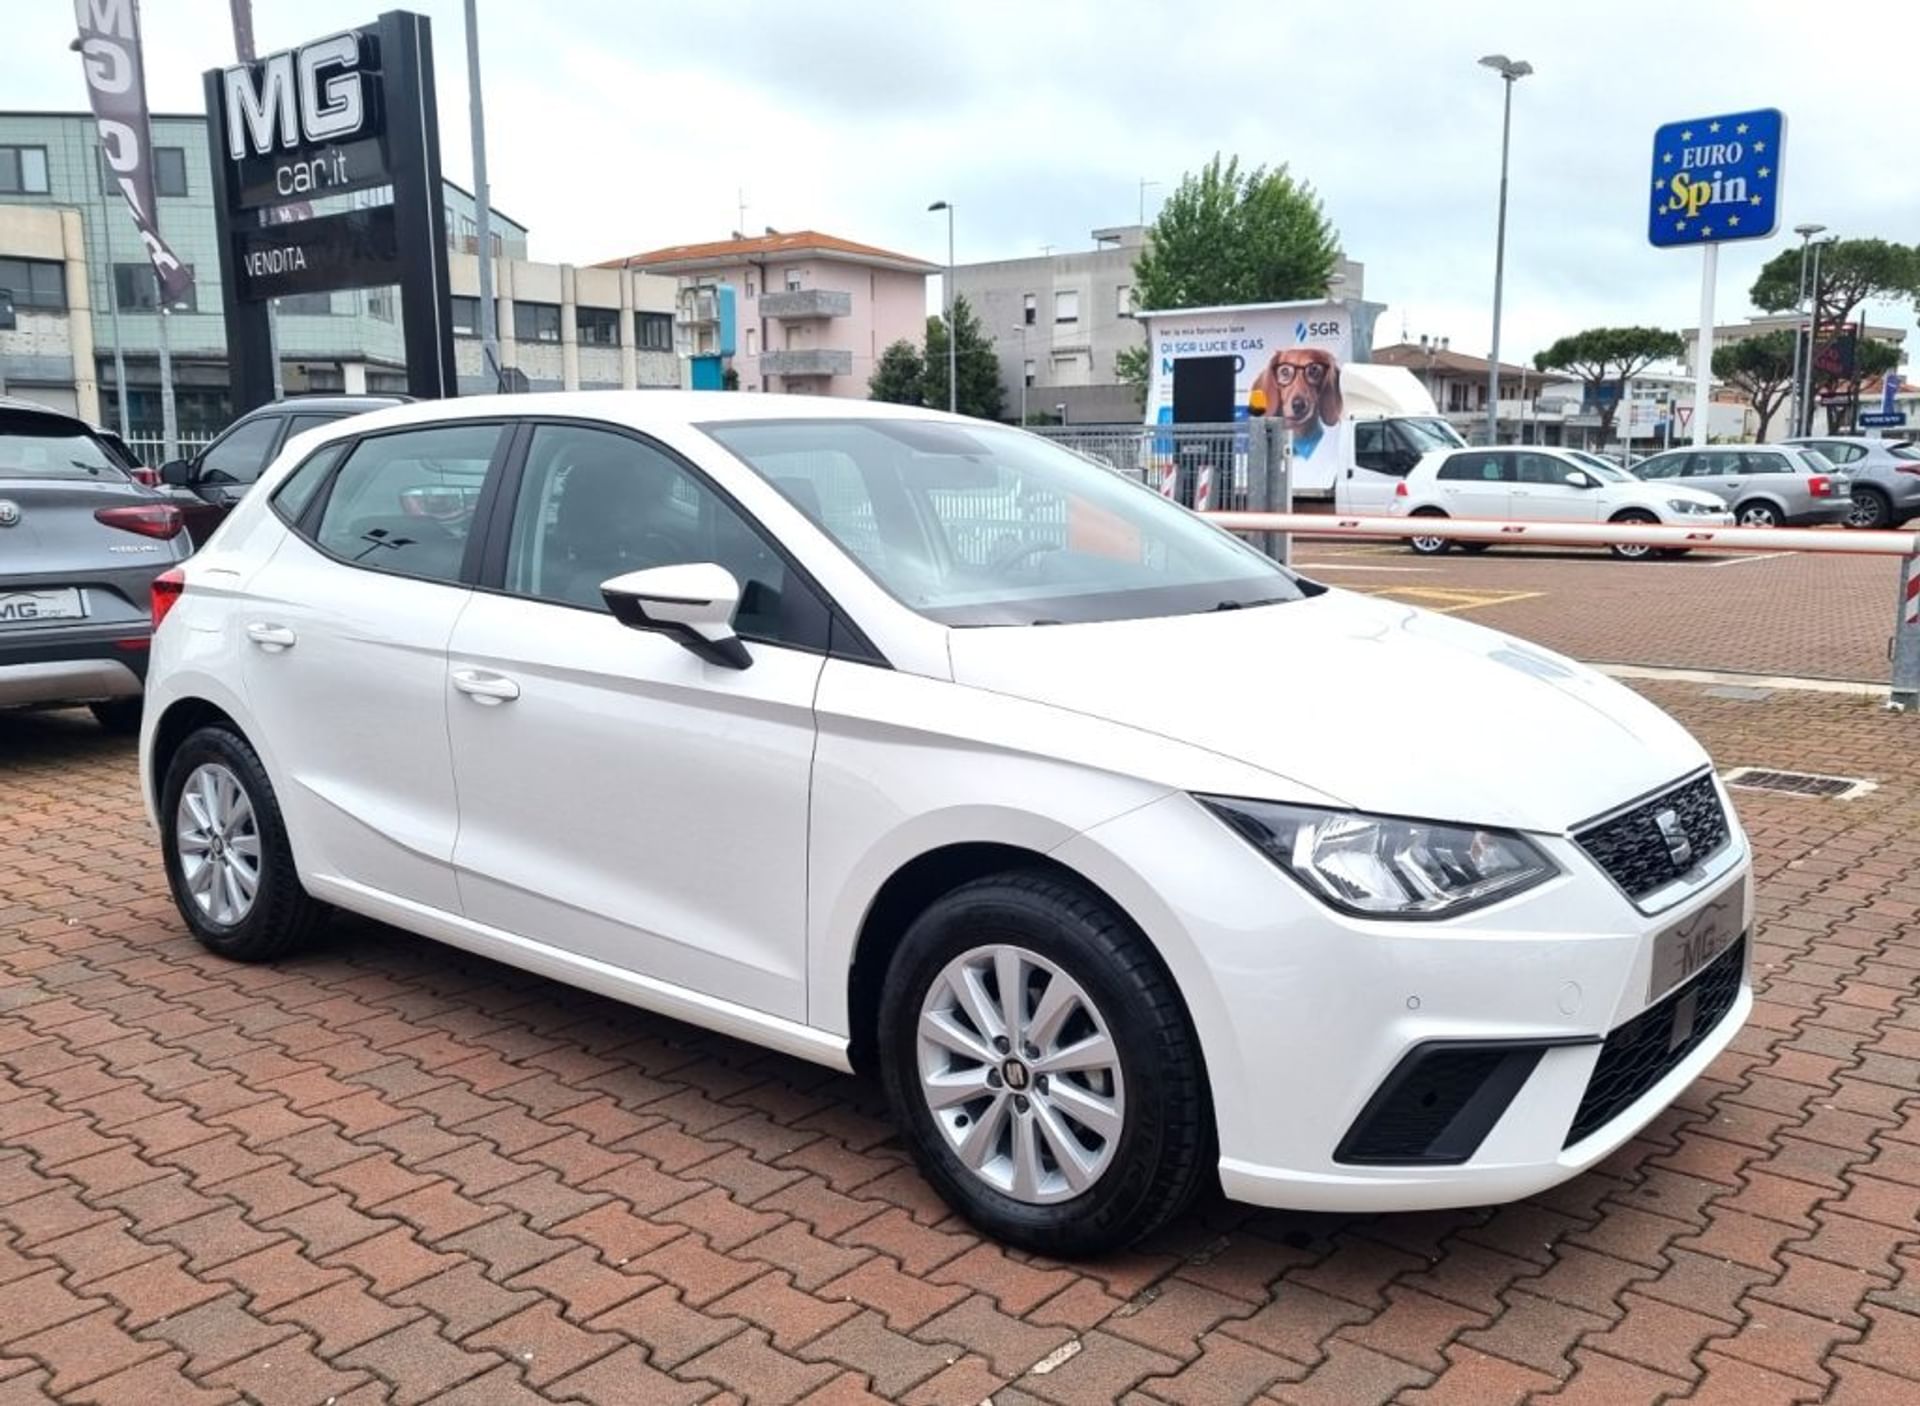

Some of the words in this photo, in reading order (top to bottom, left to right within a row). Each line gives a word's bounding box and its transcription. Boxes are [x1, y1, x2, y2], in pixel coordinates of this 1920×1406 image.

[224, 31, 363, 160] MG
[1682, 142, 1743, 168] EURO
[277, 149, 348, 195] car.it
[1669, 170, 1747, 217] Spin
[244, 246, 307, 277] VENDITA
[1309, 322, 1340, 336] SGR
[1199, 341, 1228, 352] LUCE
[1231, 341, 1239, 351] E
[1241, 338, 1264, 350] GAS
